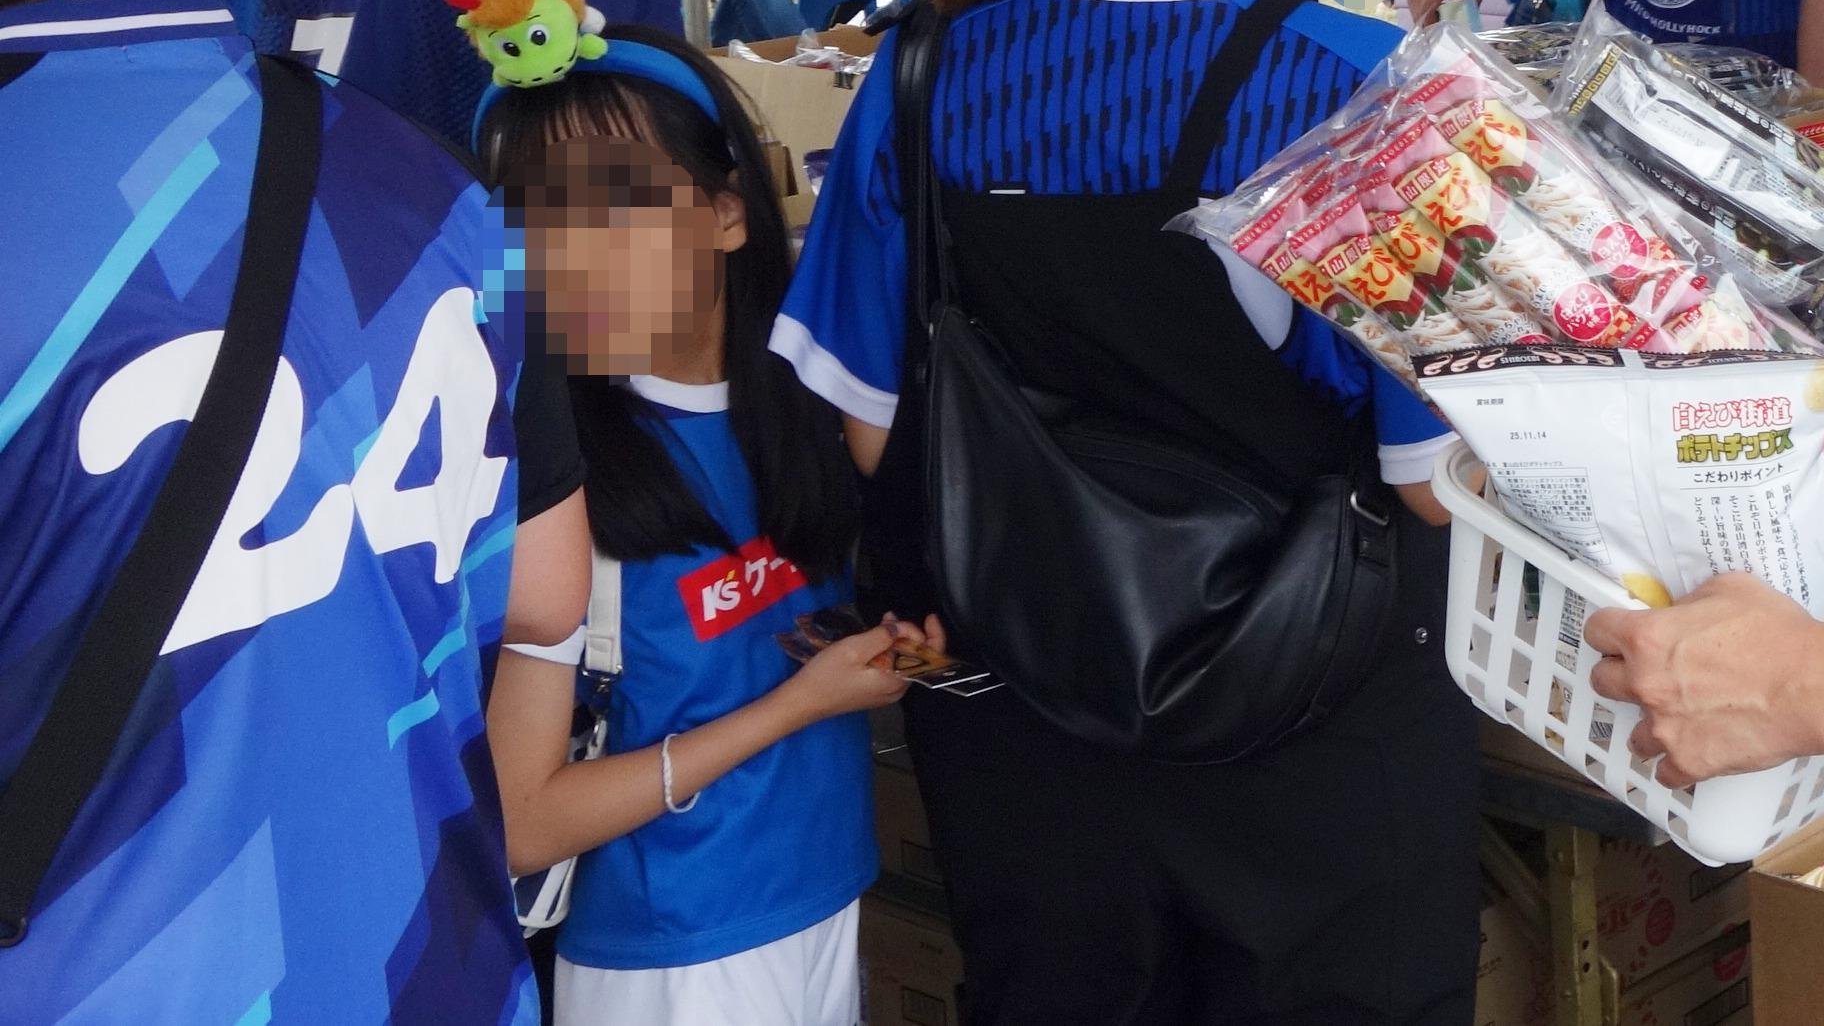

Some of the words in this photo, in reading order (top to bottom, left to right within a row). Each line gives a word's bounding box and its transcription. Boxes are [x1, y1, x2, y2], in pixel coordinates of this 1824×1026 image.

[1500, 356, 1541, 365] SHIROEBI
[1672, 396, 1793, 432] 白えび街道
[1509, 431, 1547, 440] 25.11.14
[1676, 427, 1794, 463] ポテトチップス
[77, 286, 513, 657] 24
[1693, 463, 1785, 483] こだわりポイント
